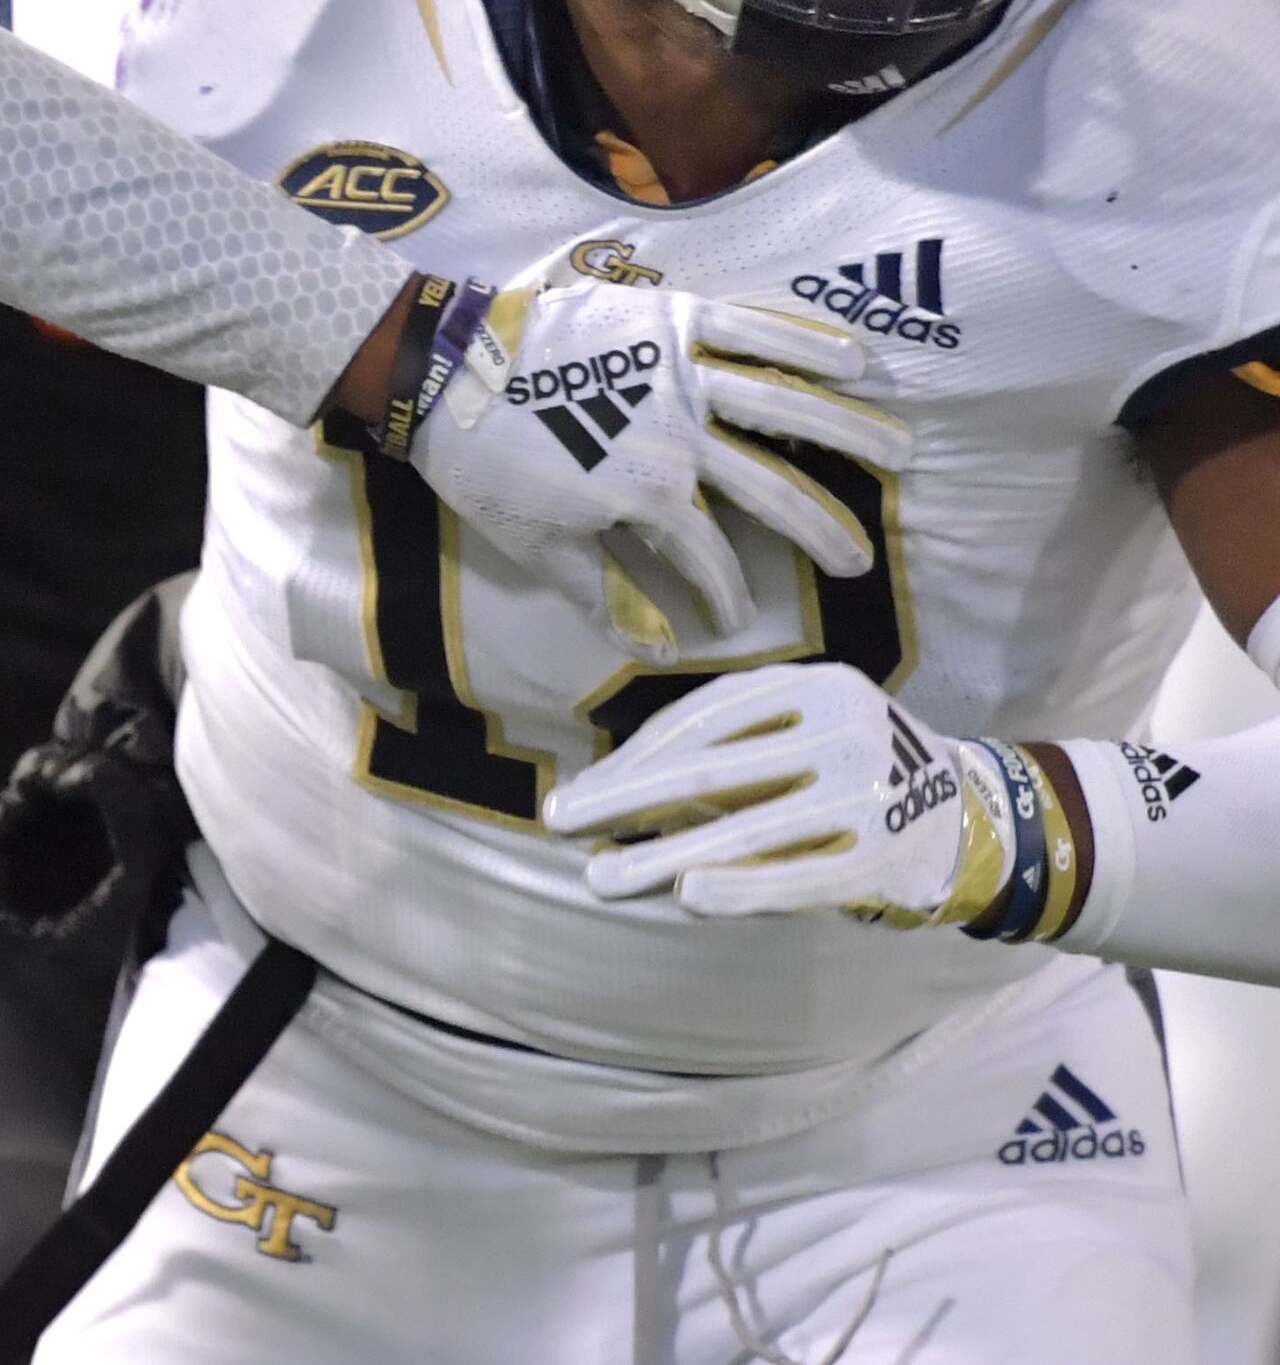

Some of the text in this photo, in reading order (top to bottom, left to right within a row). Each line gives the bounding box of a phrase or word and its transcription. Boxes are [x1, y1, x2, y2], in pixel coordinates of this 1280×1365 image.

[295, 164, 422, 202] ACC
[570, 239, 664, 286] GT
[791, 274, 962, 350] adidas
[505, 340, 661, 406] adidas
[885, 767, 958, 833] adidas
[997, 1128, 1146, 1165] adidas
[173, 1130, 338, 1262] GT
